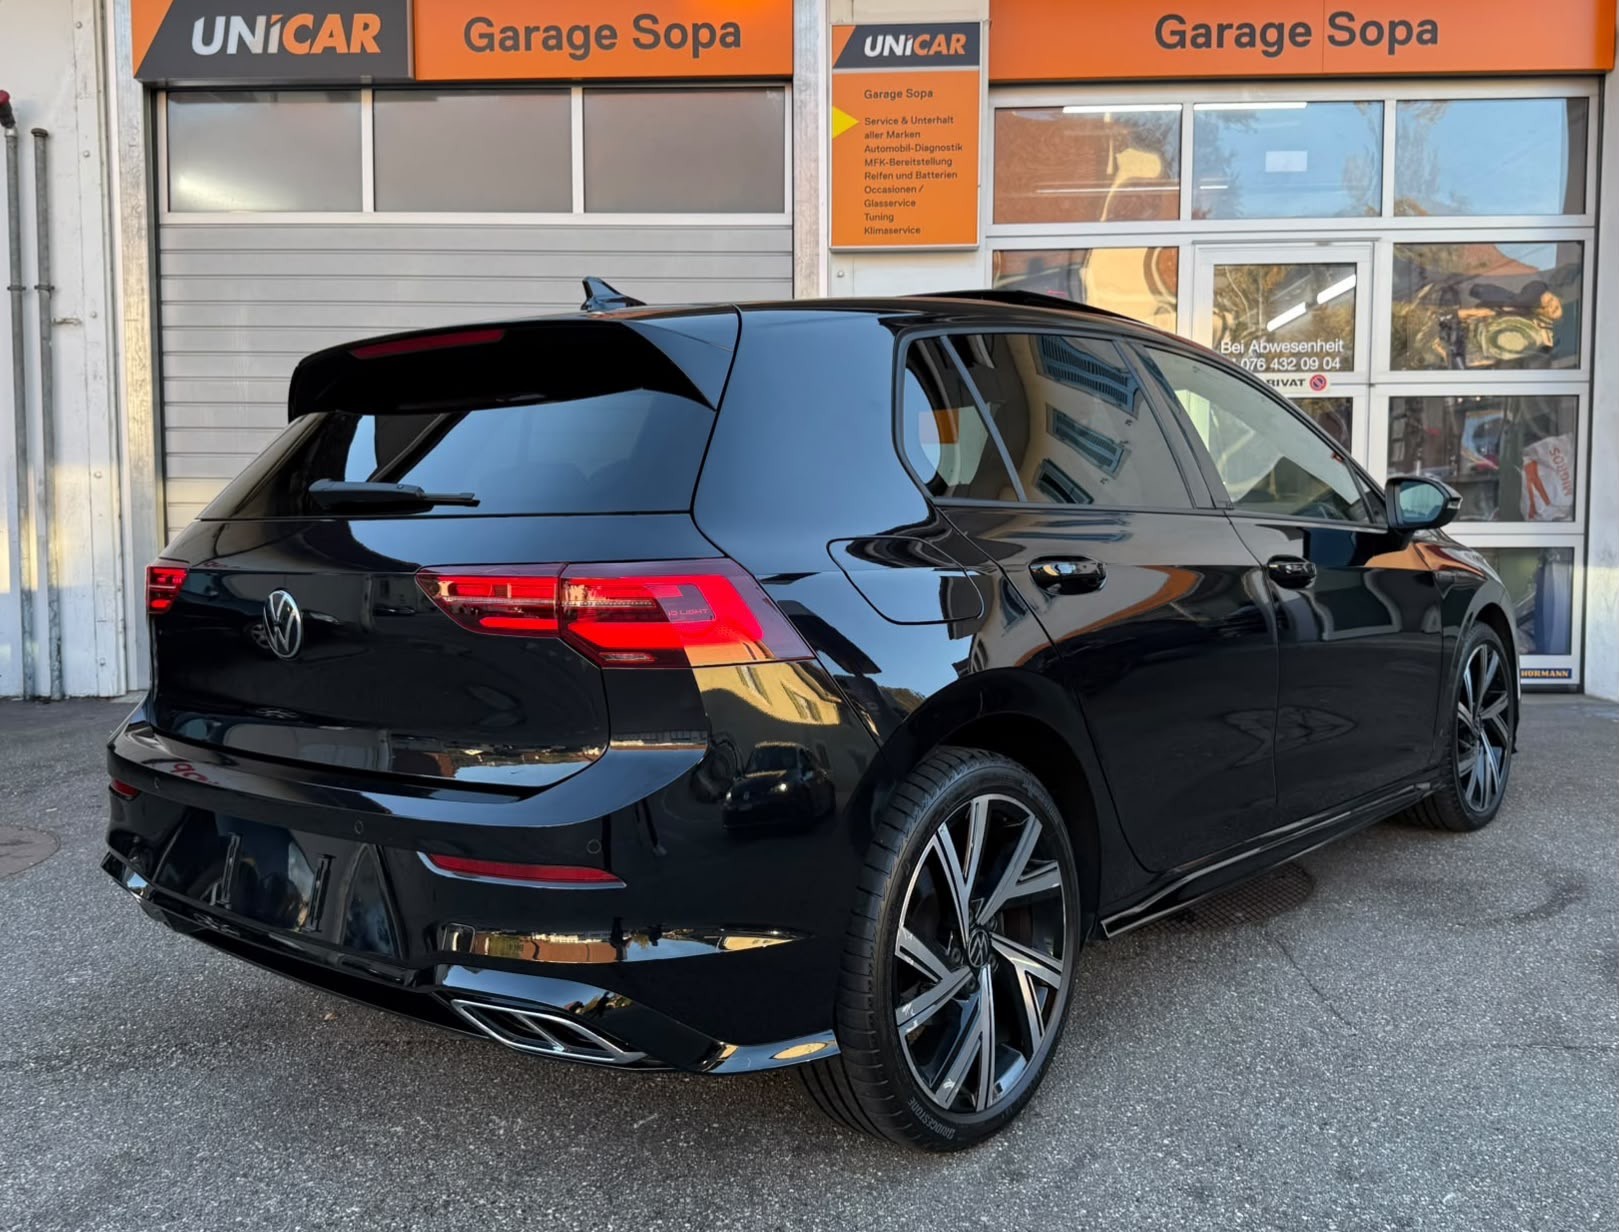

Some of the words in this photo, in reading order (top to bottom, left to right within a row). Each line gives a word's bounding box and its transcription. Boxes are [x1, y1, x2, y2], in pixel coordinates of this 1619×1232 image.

[463, 16, 618, 61] Garage
[632, 13, 741, 59] Sopa
[1155, 14, 1312, 58] Garage
[1327, 11, 1438, 55] Sopa
[864, 89, 903, 101] Garage
[906, 88, 933, 99] Sopa
[864, 117, 899, 126] Service
[901, 116, 908, 125] &
[911, 115, 954, 125] Unterhalt
[864, 131, 883, 139] aller
[886, 130, 921, 139] Marken
[864, 143, 963, 153] Automobil-Diagnostik
[864, 157, 953, 167] MFK-Bereitstellung
[864, 171, 894, 180] Reifen
[896, 171, 913, 180] und
[915, 170, 958, 180] Batterien
[864, 185, 917, 194] Occasionen
[864, 198, 916, 208] Glasservice
[864, 212, 894, 223] Tuning
[864, 226, 921, 235] Klimaservice
[1220, 341, 1244, 354] Bei
[1249, 338, 1344, 354] Abwesenheit
[1240, 358, 1266, 371] 076
[1270, 357, 1297, 370] 432
[1300, 357, 1319, 370] 09
[1323, 356, 1341, 370] 04
[1265, 379, 1306, 387] RIVAT
